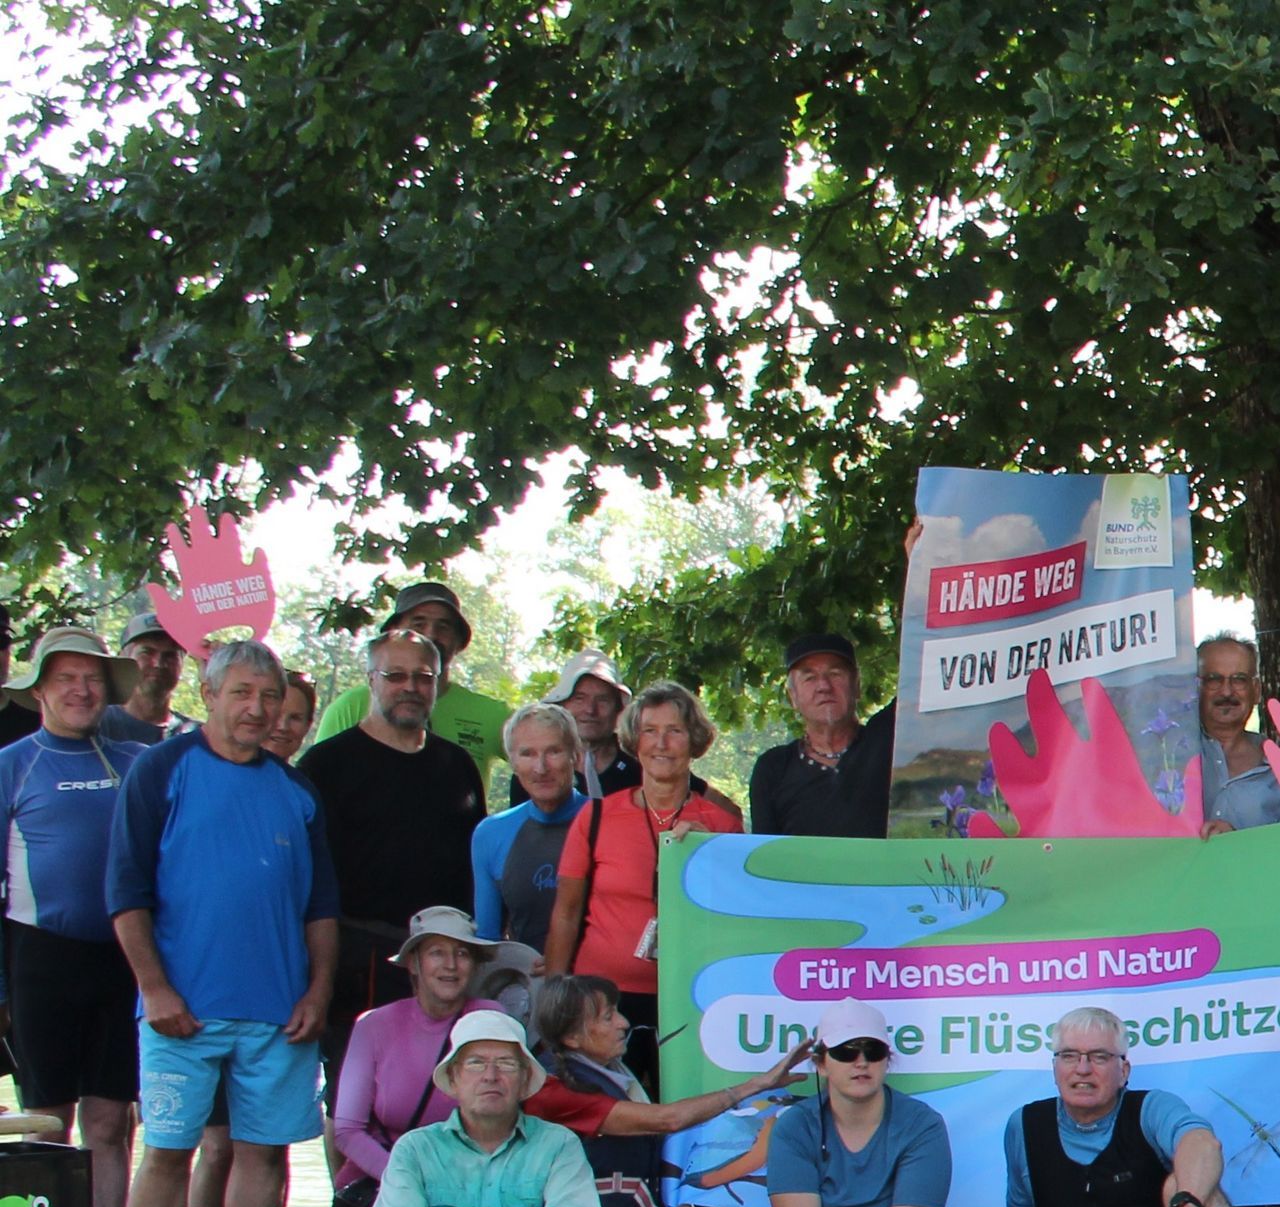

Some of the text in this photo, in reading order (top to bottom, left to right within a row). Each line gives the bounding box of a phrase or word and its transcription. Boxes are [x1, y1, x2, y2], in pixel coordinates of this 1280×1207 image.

[1105, 535, 1158, 545] Naturschutz
[1106, 523, 1134, 533] BUND
[1105, 547, 1112, 555] in
[1113, 546, 1143, 556] Bayern
[192, 575, 266, 604] HÄNDE WEG
[939, 558, 1076, 613] HÄNDE WEG
[196, 591, 269, 615] VON DER NATUR!
[940, 610, 1157, 691] VON DER NATUR!
[799, 944, 1199, 990] Für Mensch und Natur
[738, 1013, 925, 1056] Une
